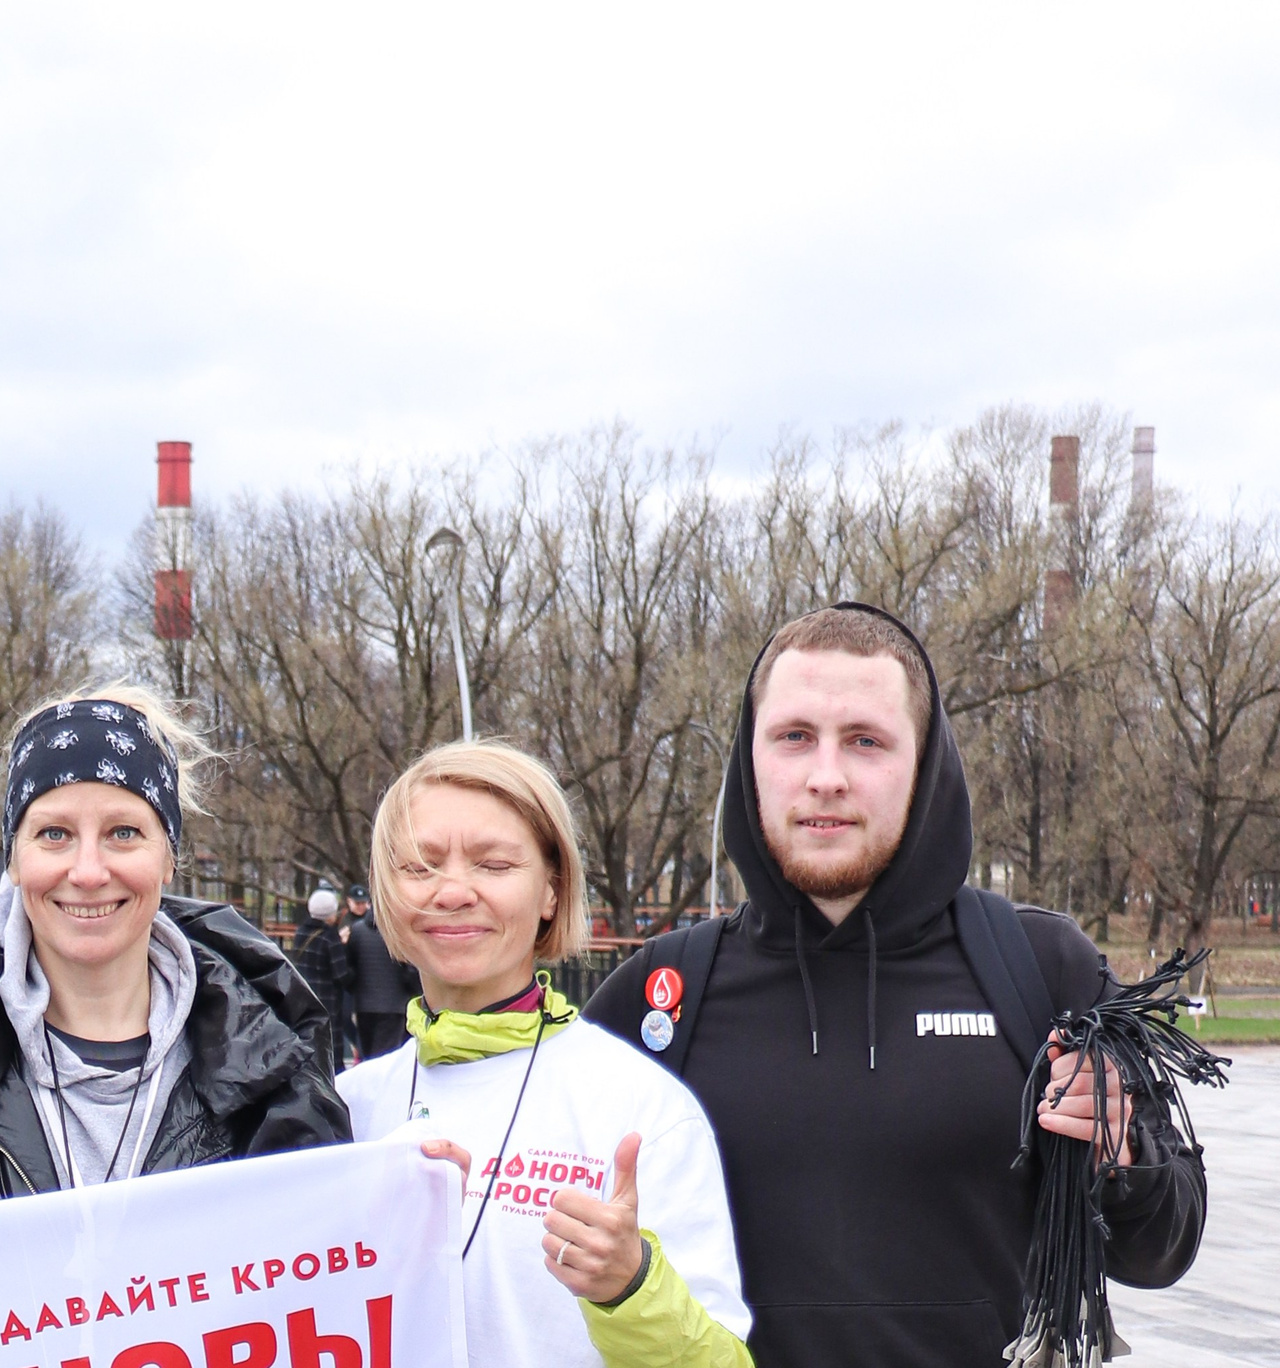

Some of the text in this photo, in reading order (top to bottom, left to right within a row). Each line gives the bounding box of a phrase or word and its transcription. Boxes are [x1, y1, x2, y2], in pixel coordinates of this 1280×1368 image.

[915, 1012, 997, 1037] PUMA
[527, 1148, 579, 1161] СДАВАЙТЕ
[494, 1182, 558, 1208] РОС
[501, 1205, 548, 1218] ПУЛЬСИР
[231, 1241, 378, 1294] КРОВЬ
